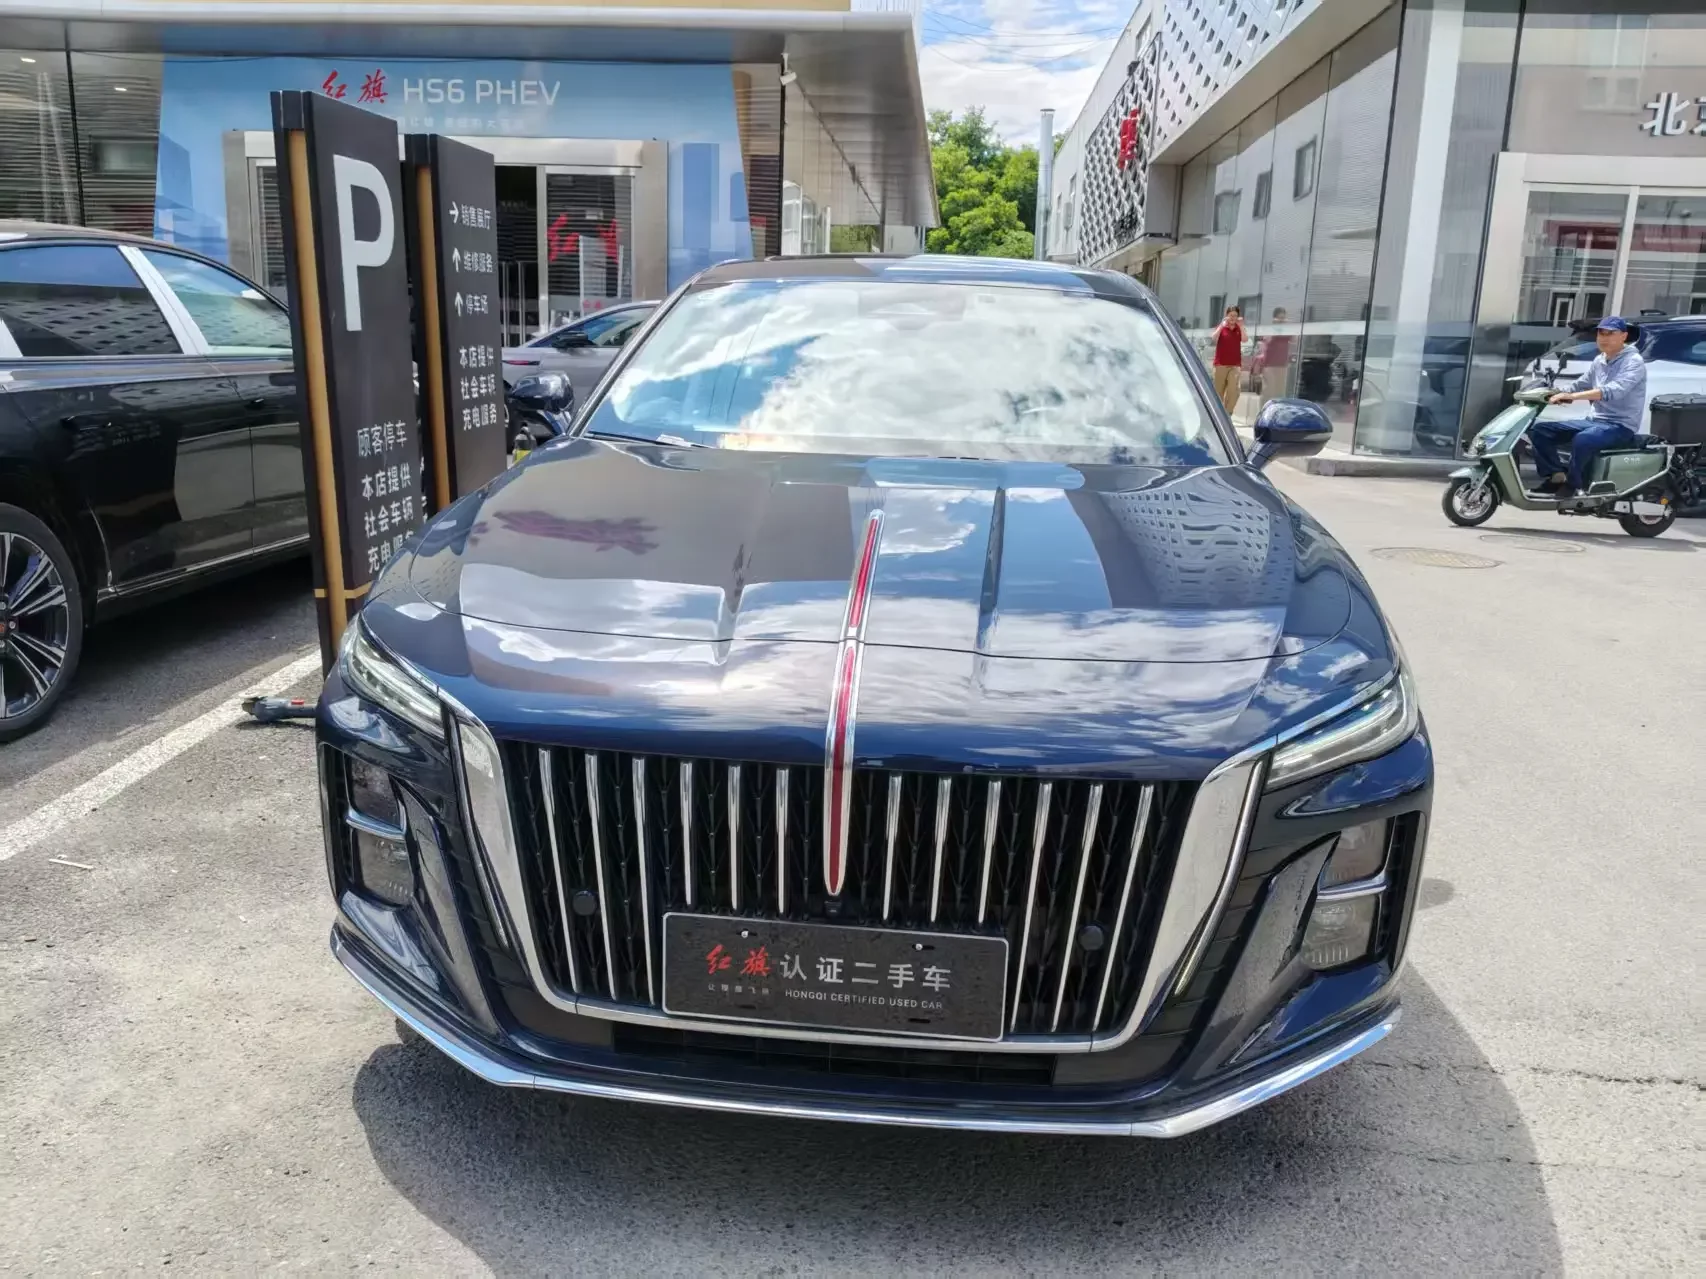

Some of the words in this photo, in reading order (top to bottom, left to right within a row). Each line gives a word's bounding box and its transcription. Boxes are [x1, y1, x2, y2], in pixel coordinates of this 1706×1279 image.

[322, 69, 389, 104] 红旗
[403, 78, 465, 103] HS6
[475, 80, 561, 106] PHEV
[461, 204, 491, 230] 销售展厅
[333, 154, 394, 331] P
[459, 345, 494, 369] 本店提供
[461, 373, 496, 400] 社会车辆
[462, 403, 497, 431] 充电服务
[357, 420, 408, 457] 顾客停车
[361, 463, 412, 501] 本店提供
[364, 496, 414, 539] 社会车辆
[706, 944, 771, 977] 红旗
[779, 953, 951, 992] 认证二手车
[785, 989, 827, 1001] HONGQI
[830, 993, 885, 1005] CERTIFIED
[889, 998, 918, 1008] USED
[921, 1000, 943, 1009] CAR
